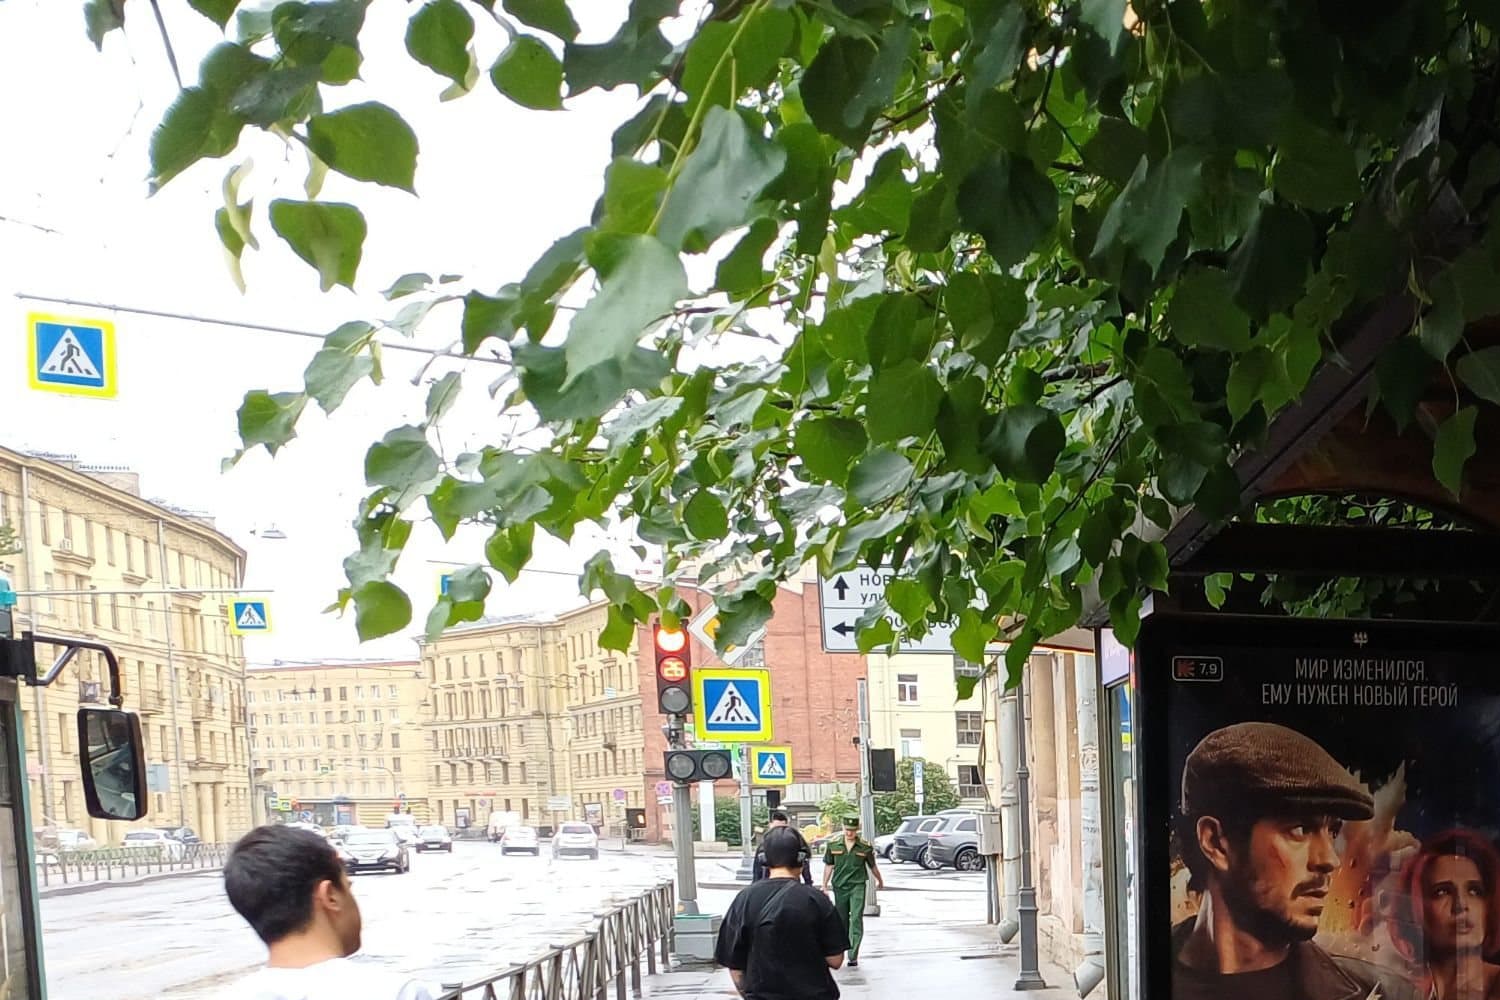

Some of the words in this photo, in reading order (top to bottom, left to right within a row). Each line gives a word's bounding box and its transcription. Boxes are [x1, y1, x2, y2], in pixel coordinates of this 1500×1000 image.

[1295, 658, 1329, 680] МИР
[1261, 683, 1292, 705] ЕМУ
[1297, 683, 1349, 706] НУЖЕН
[1353, 681, 1408, 707] НОВЫЙ
[1412, 682, 1458, 708] ГЕРОЙ
